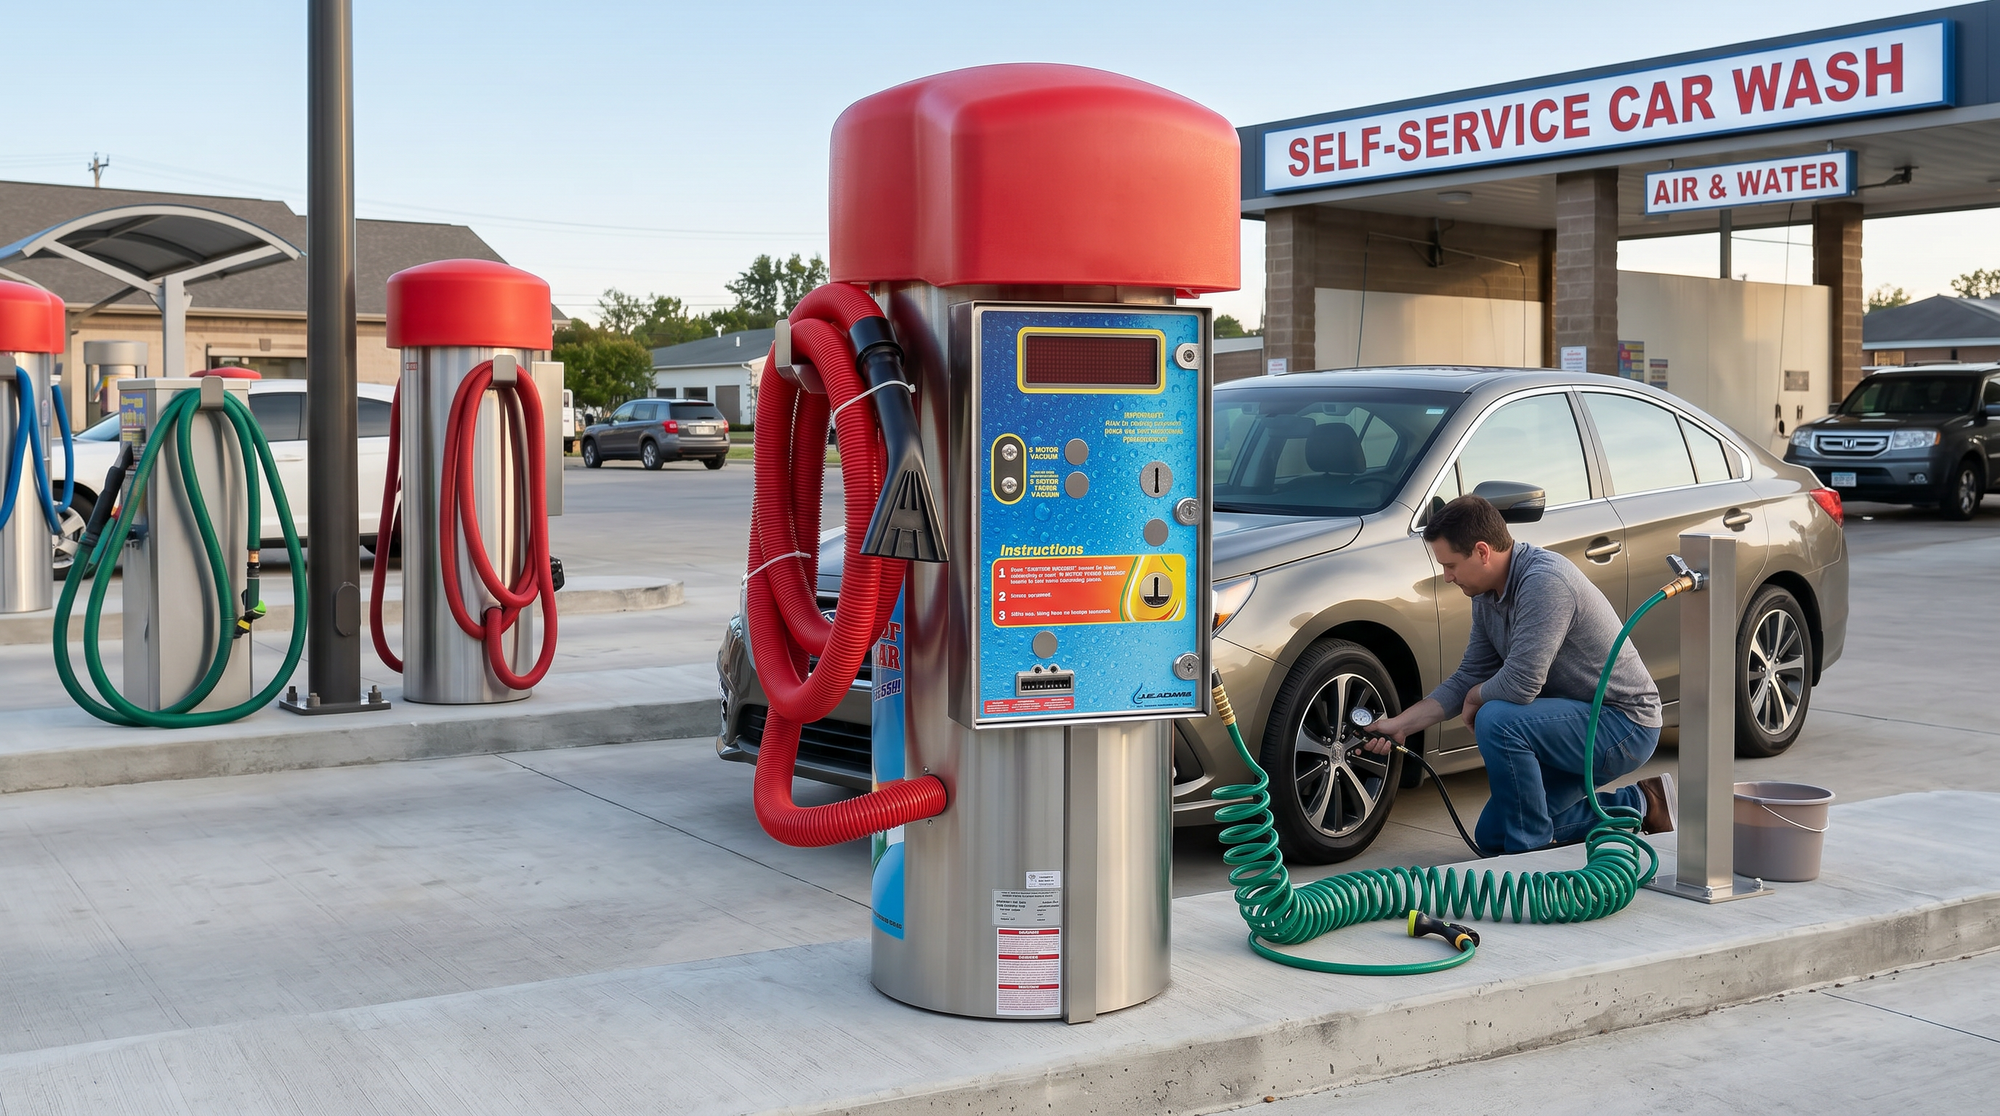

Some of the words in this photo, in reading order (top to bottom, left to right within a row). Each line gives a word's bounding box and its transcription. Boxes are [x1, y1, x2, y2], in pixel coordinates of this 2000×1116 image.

[1288, 93, 1590, 178] SELF-SERVICE
[1609, 75, 1714, 132] CAR
[1733, 43, 1904, 115] WASH
[1653, 176, 1699, 206] AIR
[1708, 174, 1728, 200] &
[1737, 160, 1839, 197] WATER
[1000, 543, 1084, 556] Instructions
[998, 567, 1006, 578] 1
[998, 591, 1006, 602] 2
[998, 610, 1006, 620] 3
